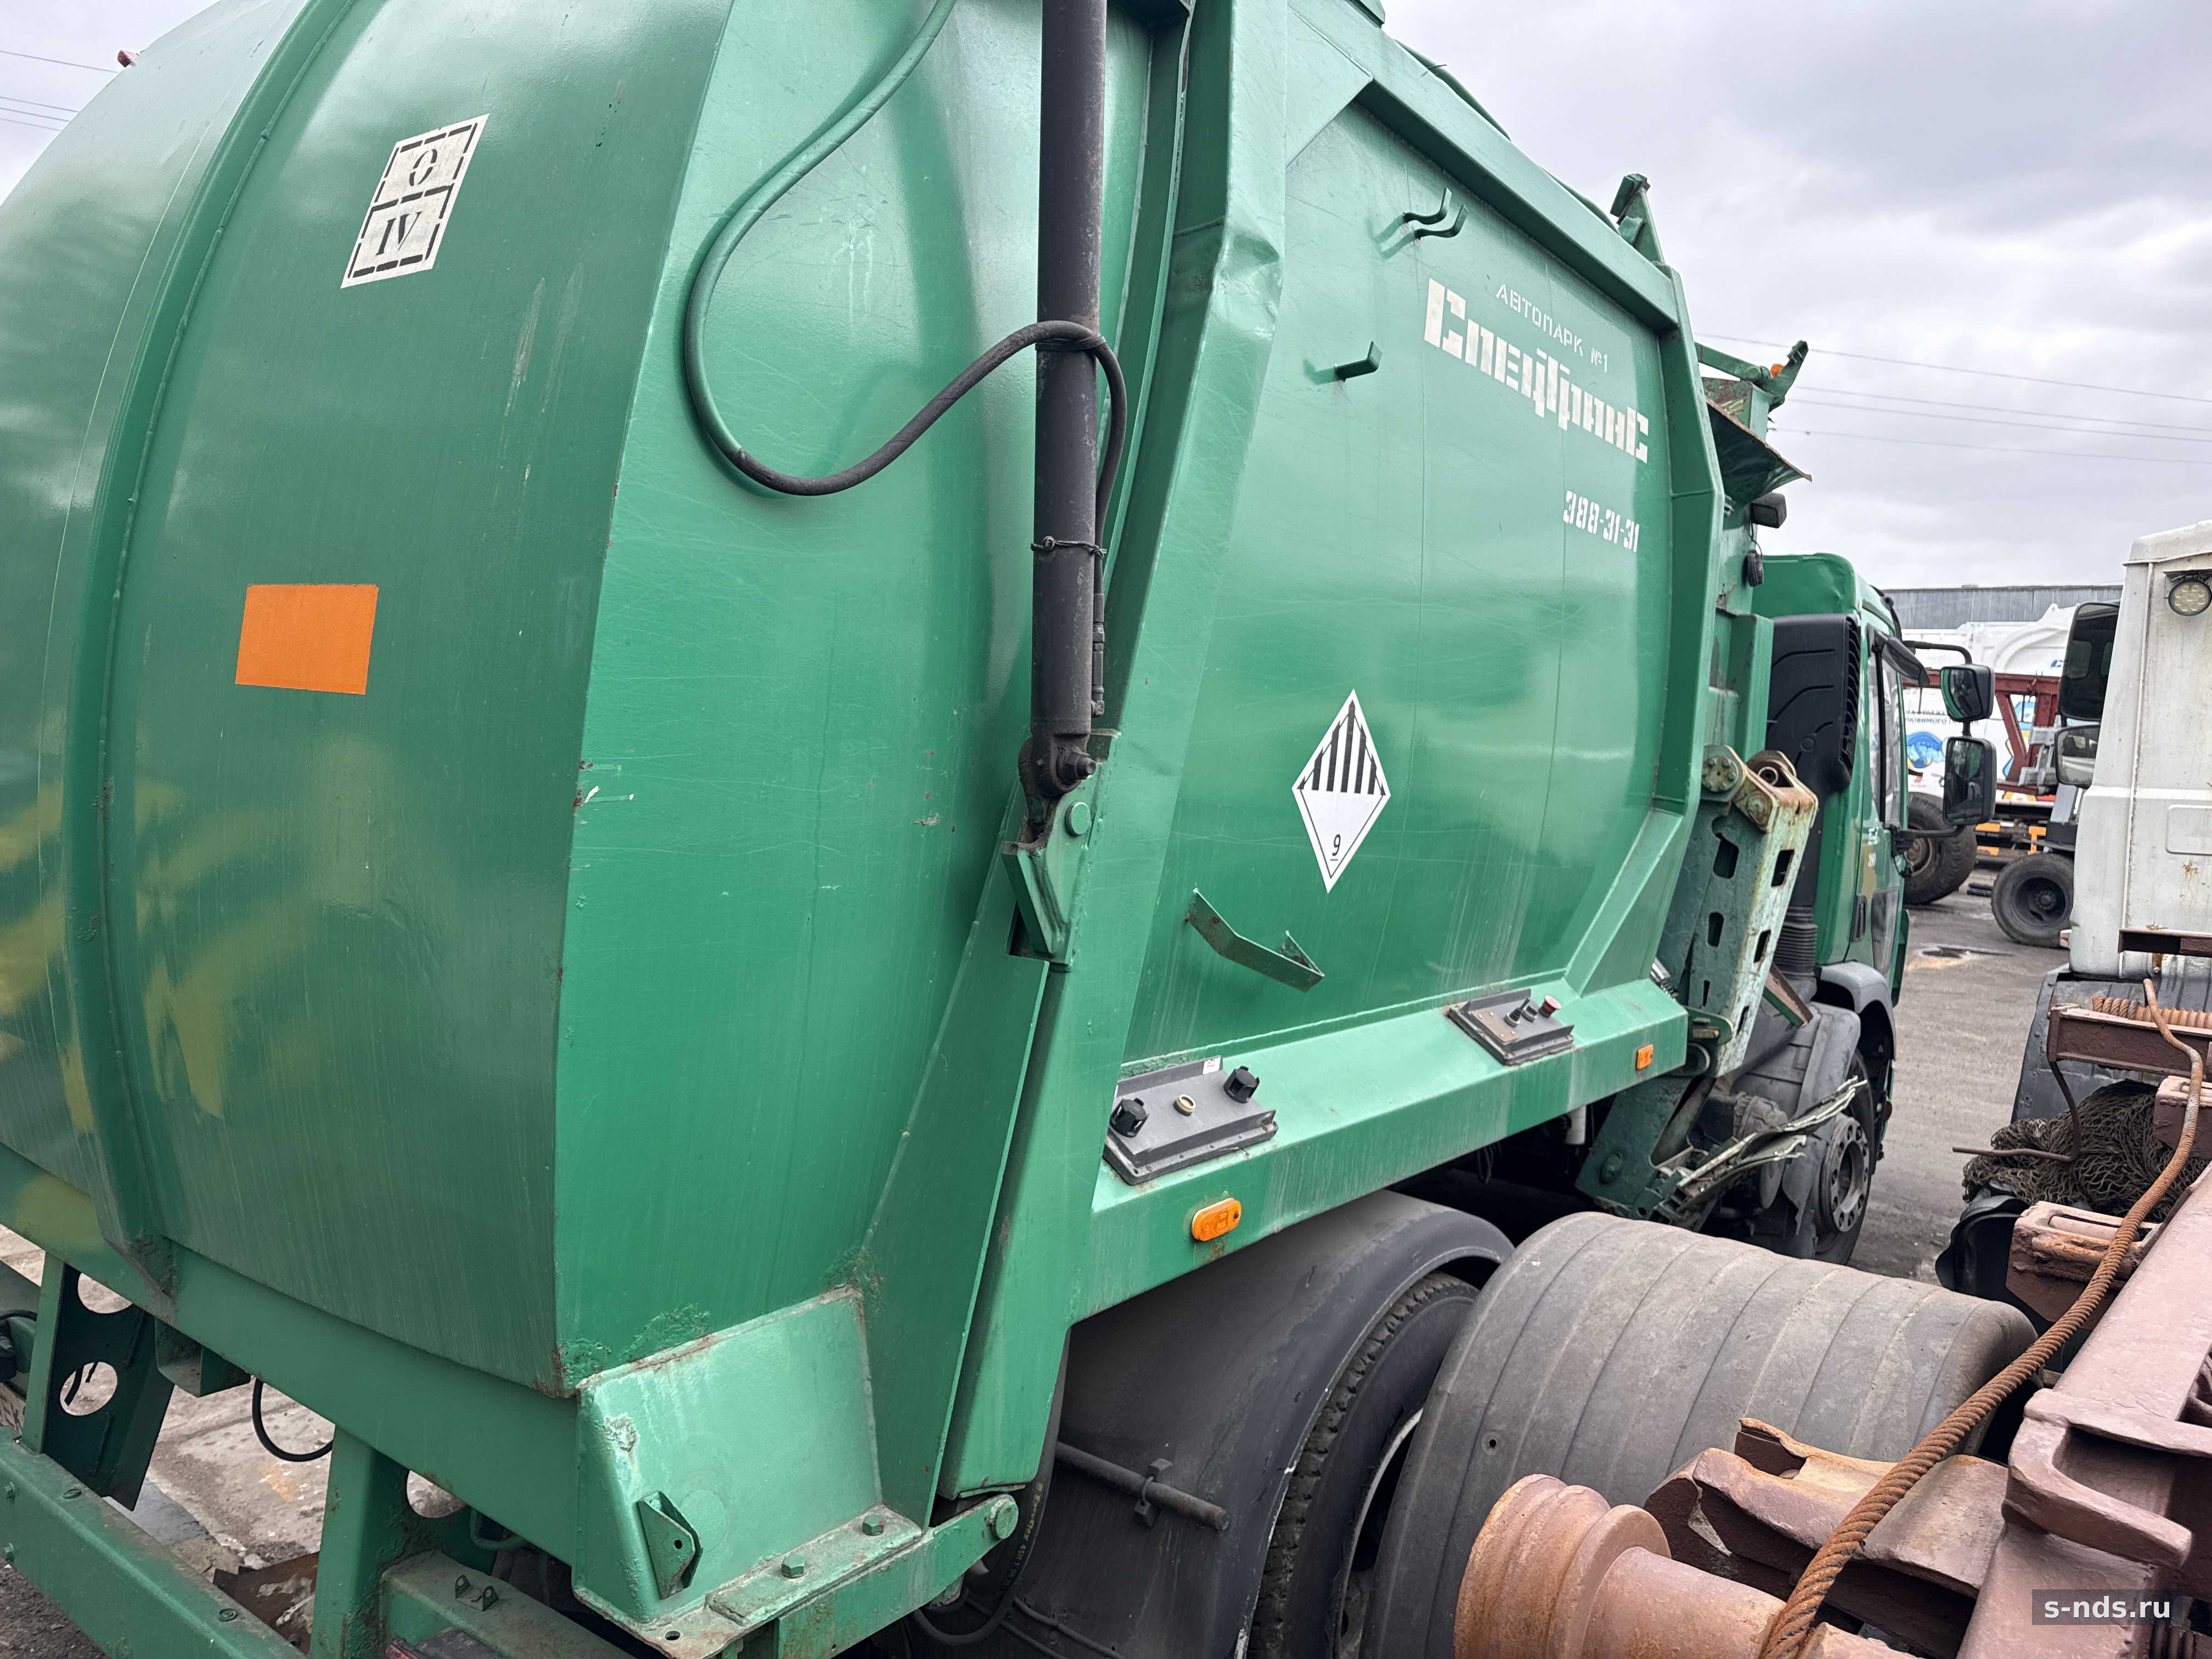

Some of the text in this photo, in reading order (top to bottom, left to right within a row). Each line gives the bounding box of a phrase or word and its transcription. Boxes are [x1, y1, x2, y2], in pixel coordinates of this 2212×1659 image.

[375, 211, 422, 256] IV
[1496, 283, 1583, 357] АВТОПАРК
[1563, 490, 1640, 553] 388-31-31
[1331, 833, 1341, 857] 9
